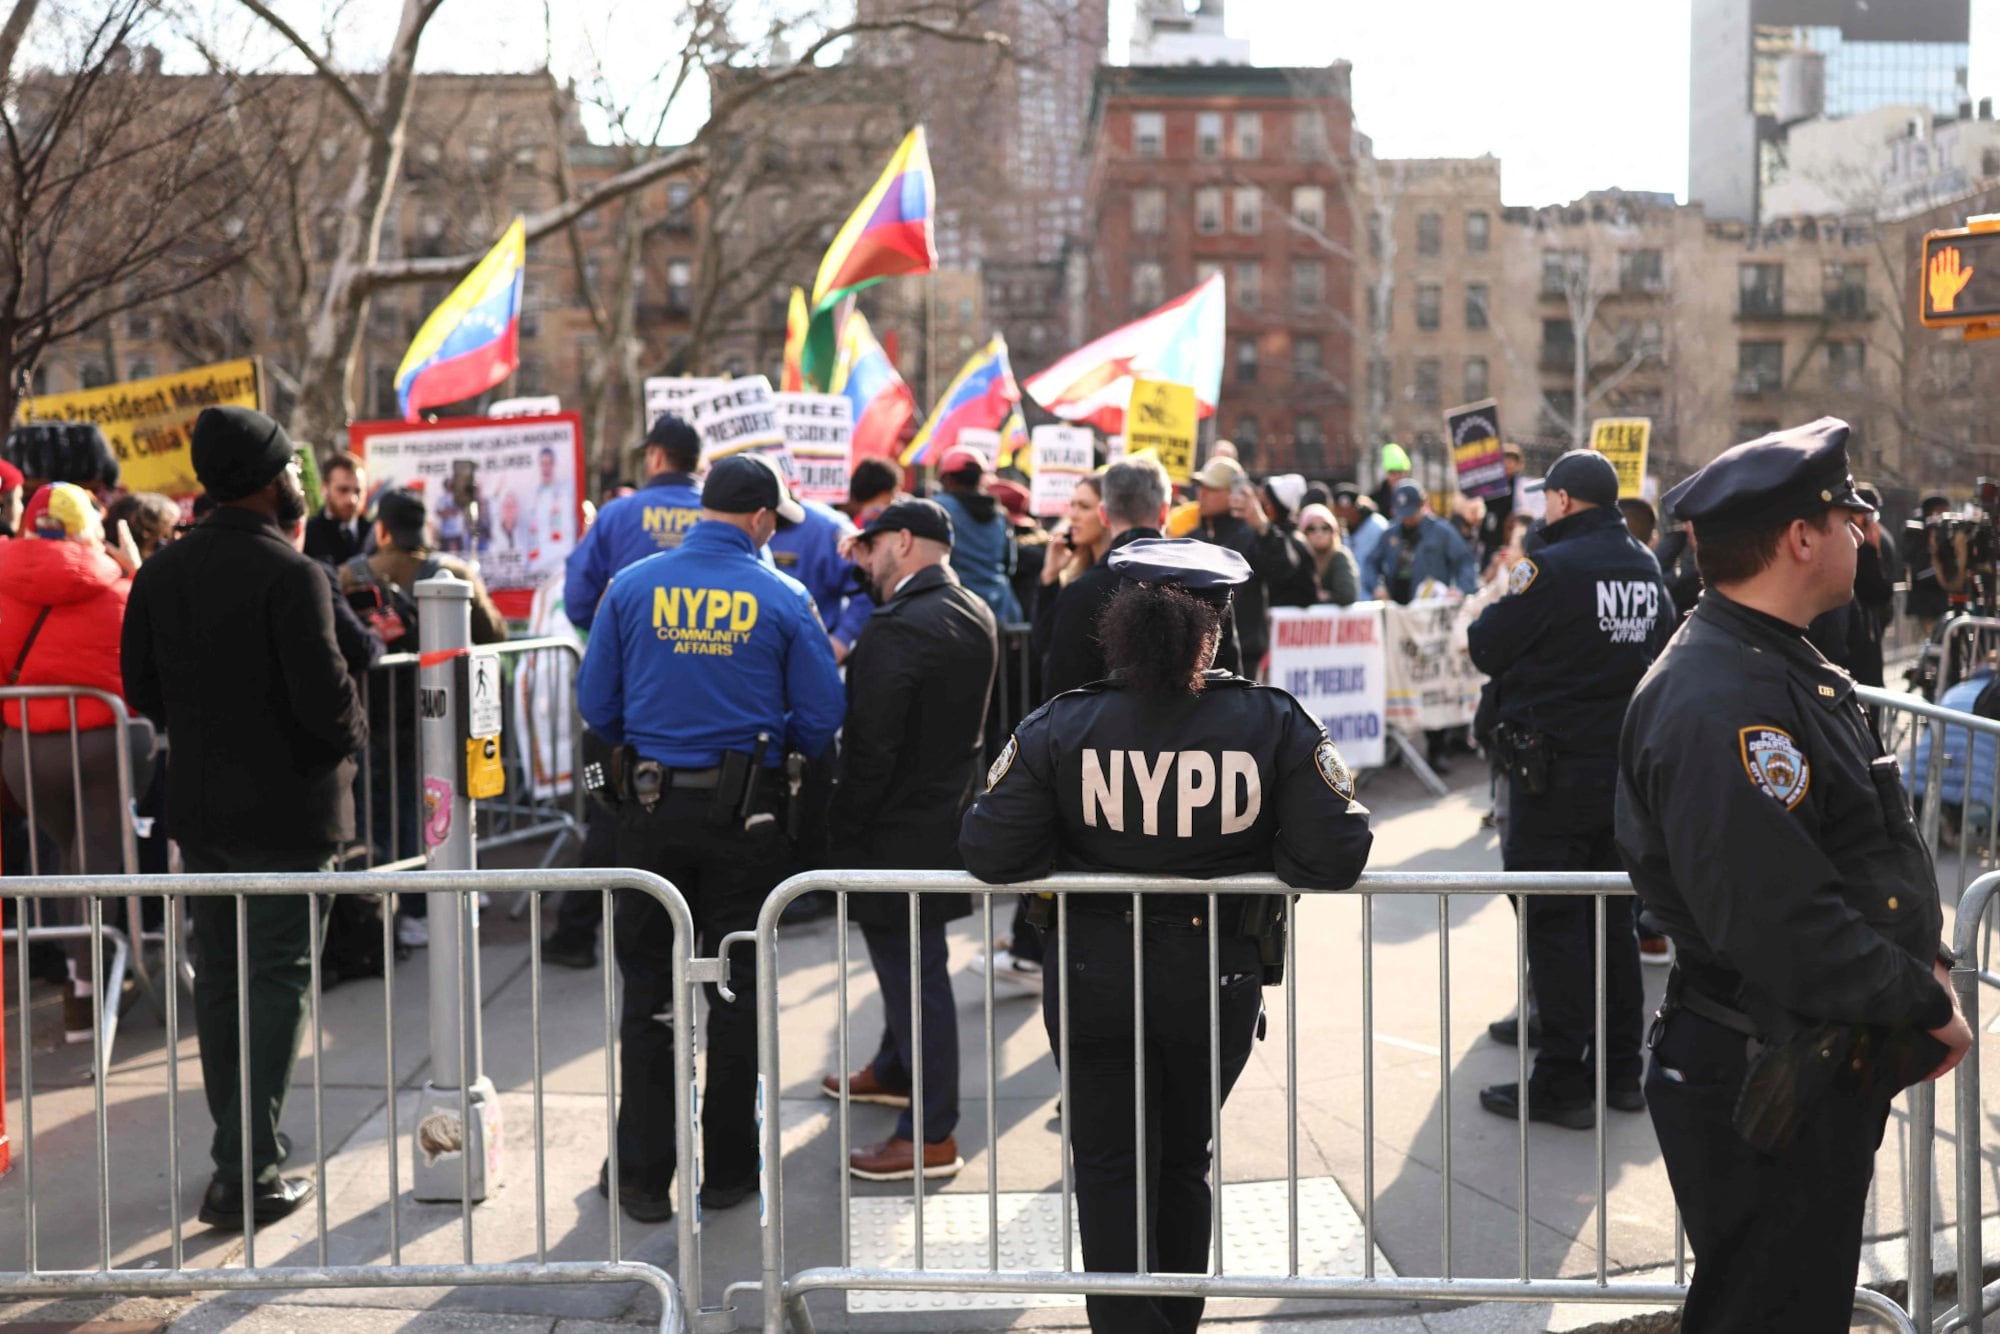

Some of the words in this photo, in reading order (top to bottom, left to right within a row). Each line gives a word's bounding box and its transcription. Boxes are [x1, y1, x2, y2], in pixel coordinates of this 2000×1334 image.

[65, 387, 169, 422] President
[692, 386, 766, 419] FREE
[111, 437, 128, 460] &
[653, 587, 758, 632] NYPD
[1596, 581, 1658, 618] NYPD
[657, 627, 751, 644] COMMUNITY
[1599, 617, 1656, 632] COMMUNITY
[674, 641, 733, 656] AFFAIRS
[1761, 731, 1792, 746] POLICE
[1750, 761, 1765, 783] CITY
[1081, 748, 1262, 838] NYPD
